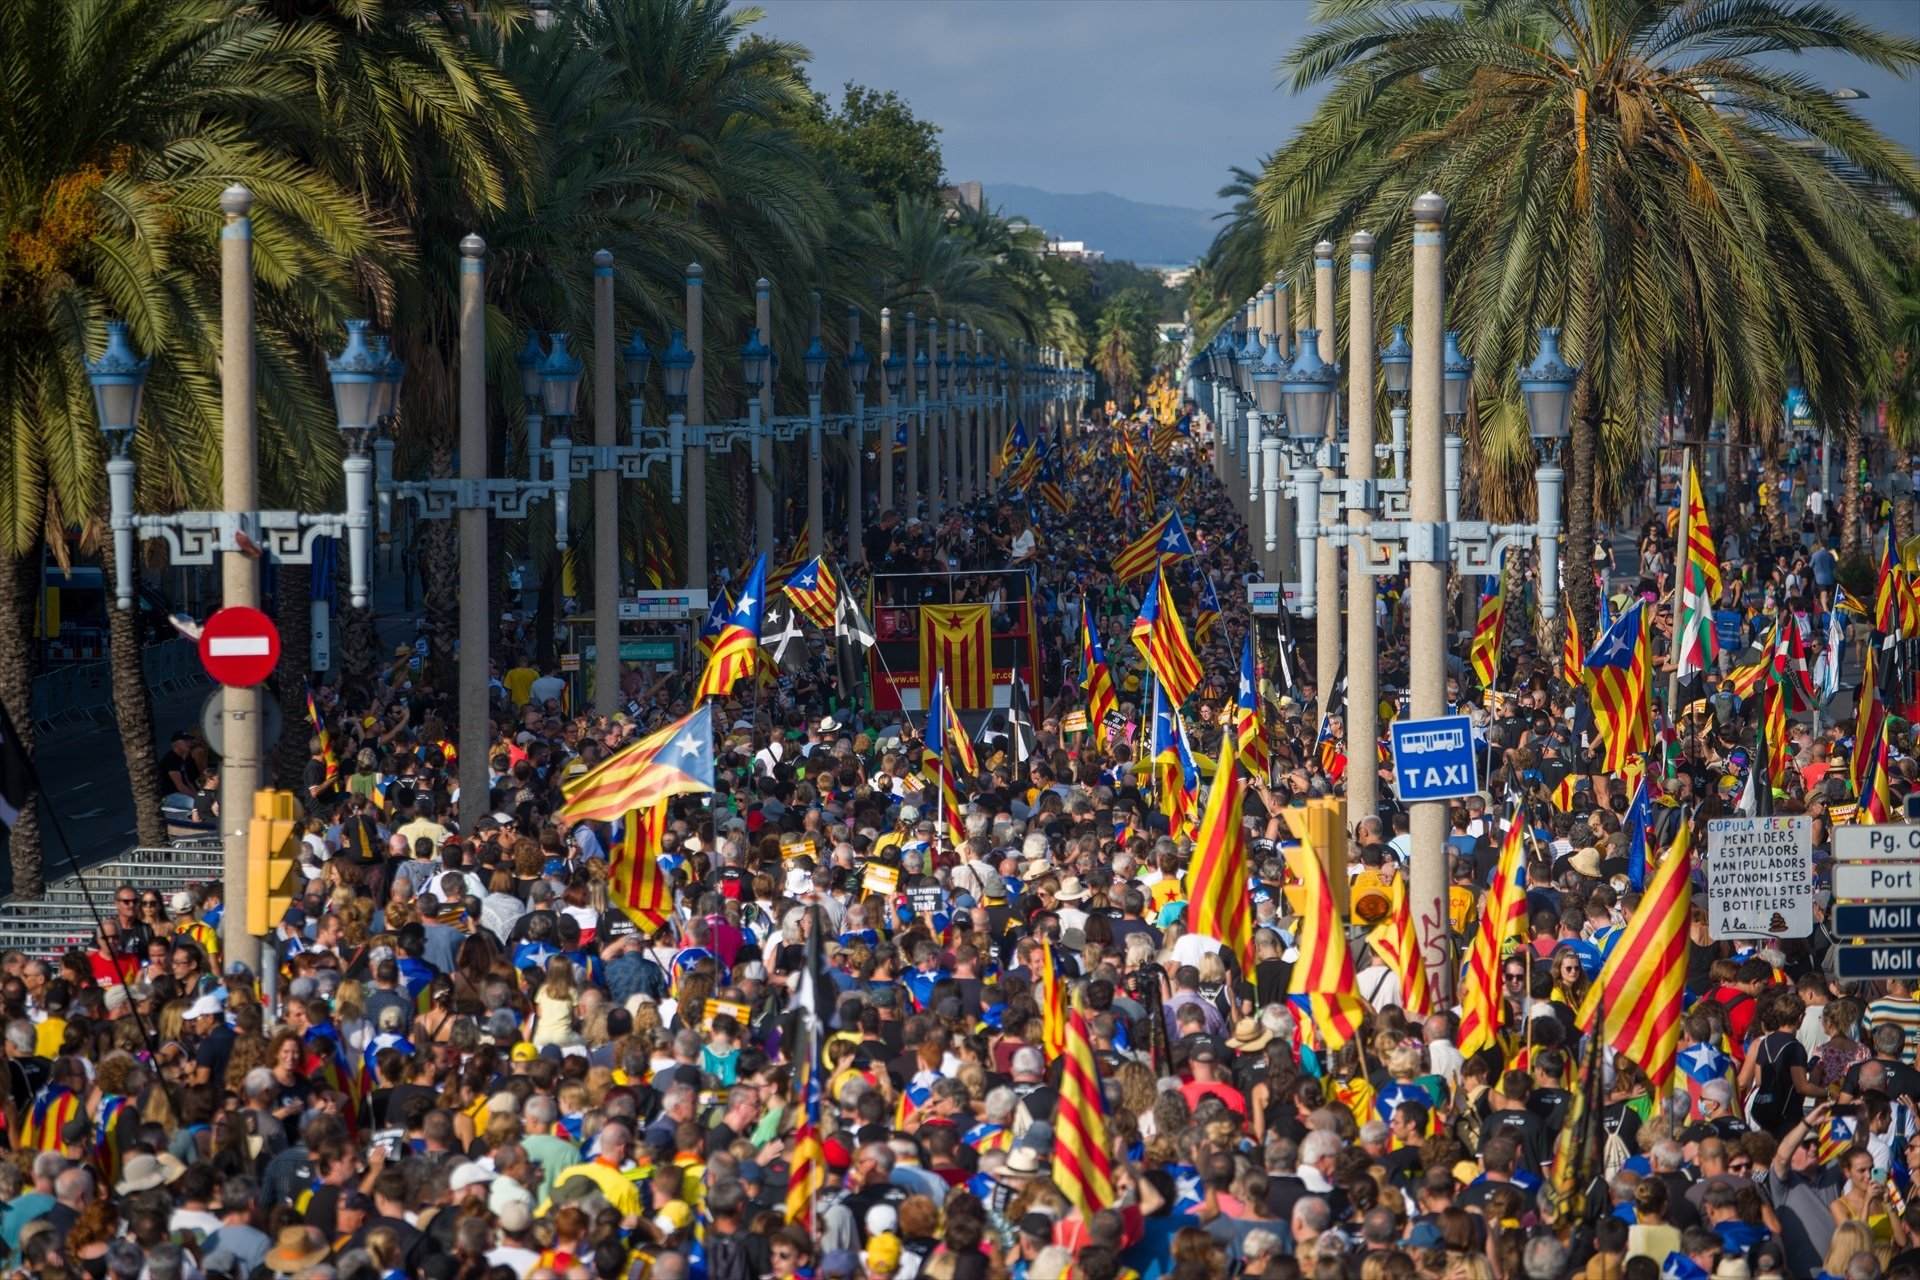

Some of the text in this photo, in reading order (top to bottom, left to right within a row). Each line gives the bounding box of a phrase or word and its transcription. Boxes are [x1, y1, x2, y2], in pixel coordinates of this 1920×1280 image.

[1404, 763, 1469, 789] TAXI
[1724, 830, 1795, 845] MENTIDERS
[1870, 831, 1901, 853] Pg.
[1713, 858, 1806, 872] MANIPULADORS
[1712, 871, 1806, 885] AUTONOMISTES
[1871, 870, 1912, 889] Port
[1709, 884, 1811, 898] ESPANYOLISTES
[1722, 898, 1796, 912] BOTIFLERS
[1720, 917, 1730, 931] A
[1869, 907, 1911, 929] Moll
[1871, 949, 1912, 970] Moll
